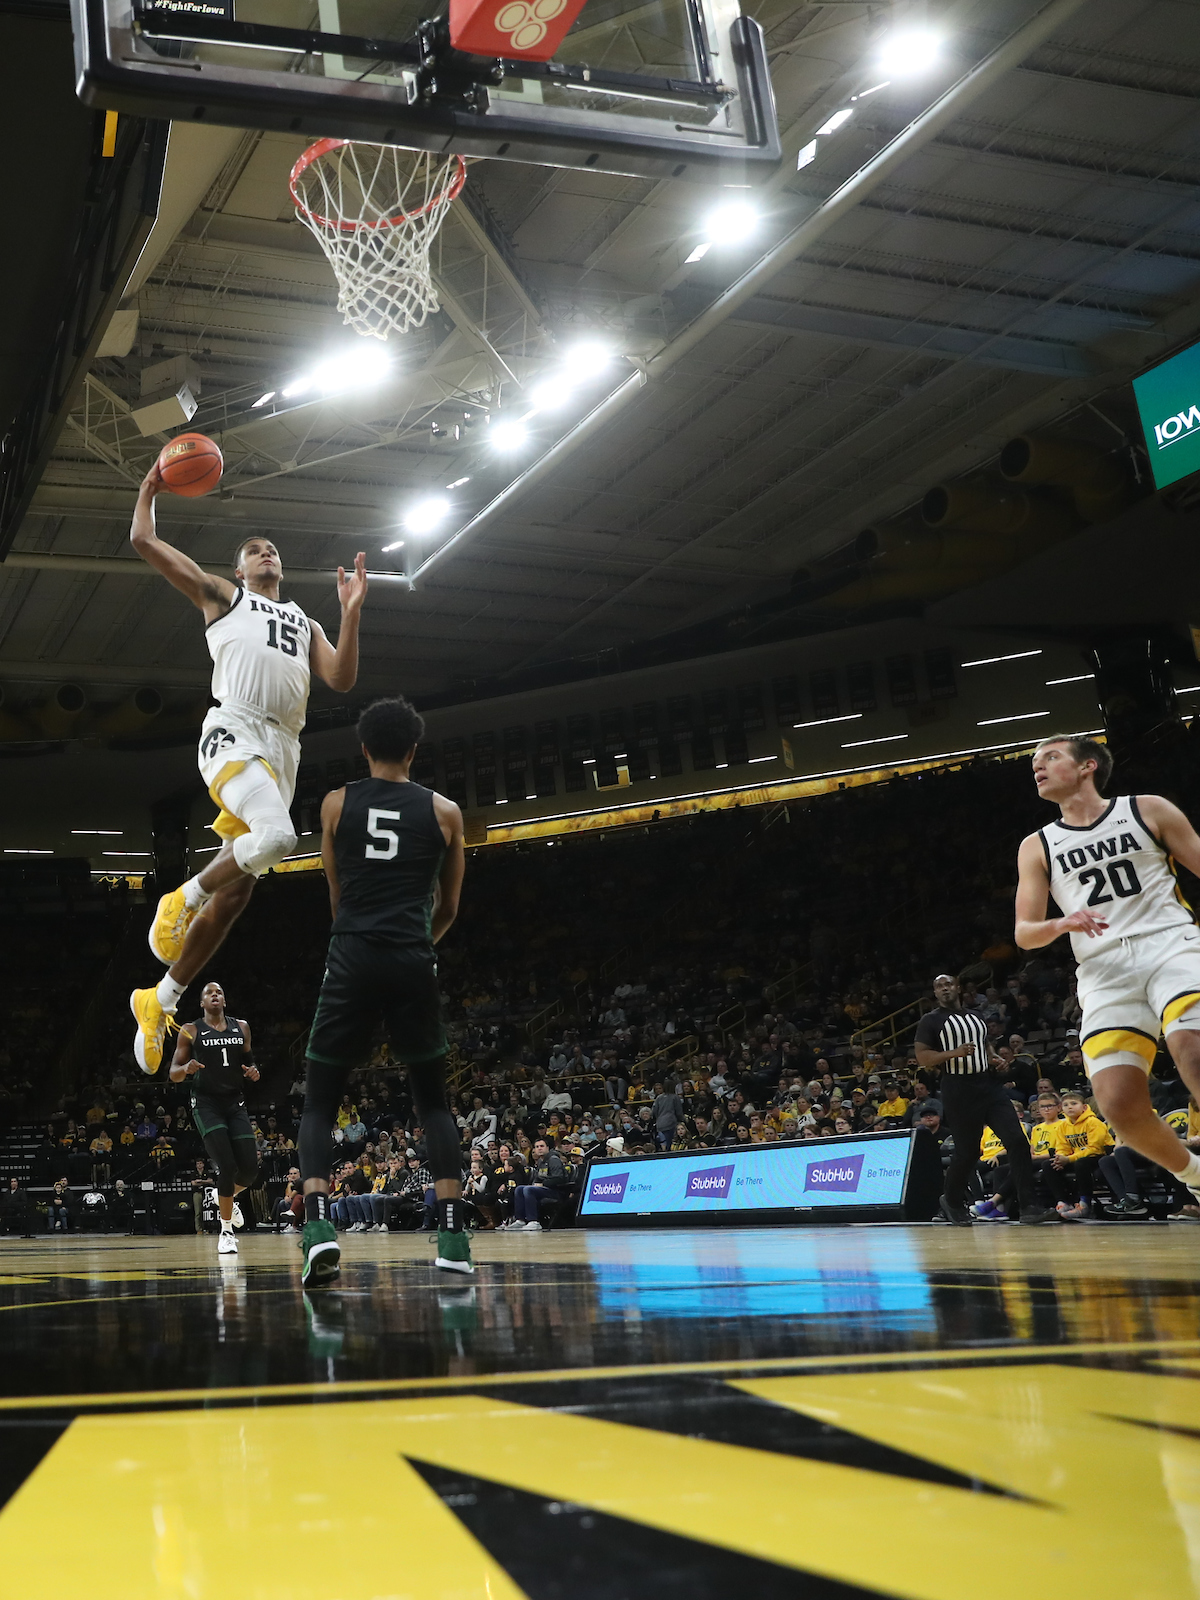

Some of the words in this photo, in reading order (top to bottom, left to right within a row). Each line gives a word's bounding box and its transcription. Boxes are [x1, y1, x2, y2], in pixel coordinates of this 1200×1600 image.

[154, 0, 225, 15] #FightForIowa
[249, 599, 309, 634] IOWA
[267, 619, 298, 657] 15
[365, 807, 400, 860] 5
[1055, 832, 1142, 875] IOWA
[1078, 859, 1142, 908] 20
[202, 1037, 244, 1046] VIKINGS
[221, 1047, 230, 1067] 1
[691, 1176, 726, 1190] StubHub
[736, 1178, 744, 1186] Be
[746, 1176, 763, 1185] There
[811, 1167, 854, 1183] StubHub
[867, 1169, 877, 1178] Be
[879, 1168, 901, 1178] There
[592, 1183, 622, 1195] StubHub
